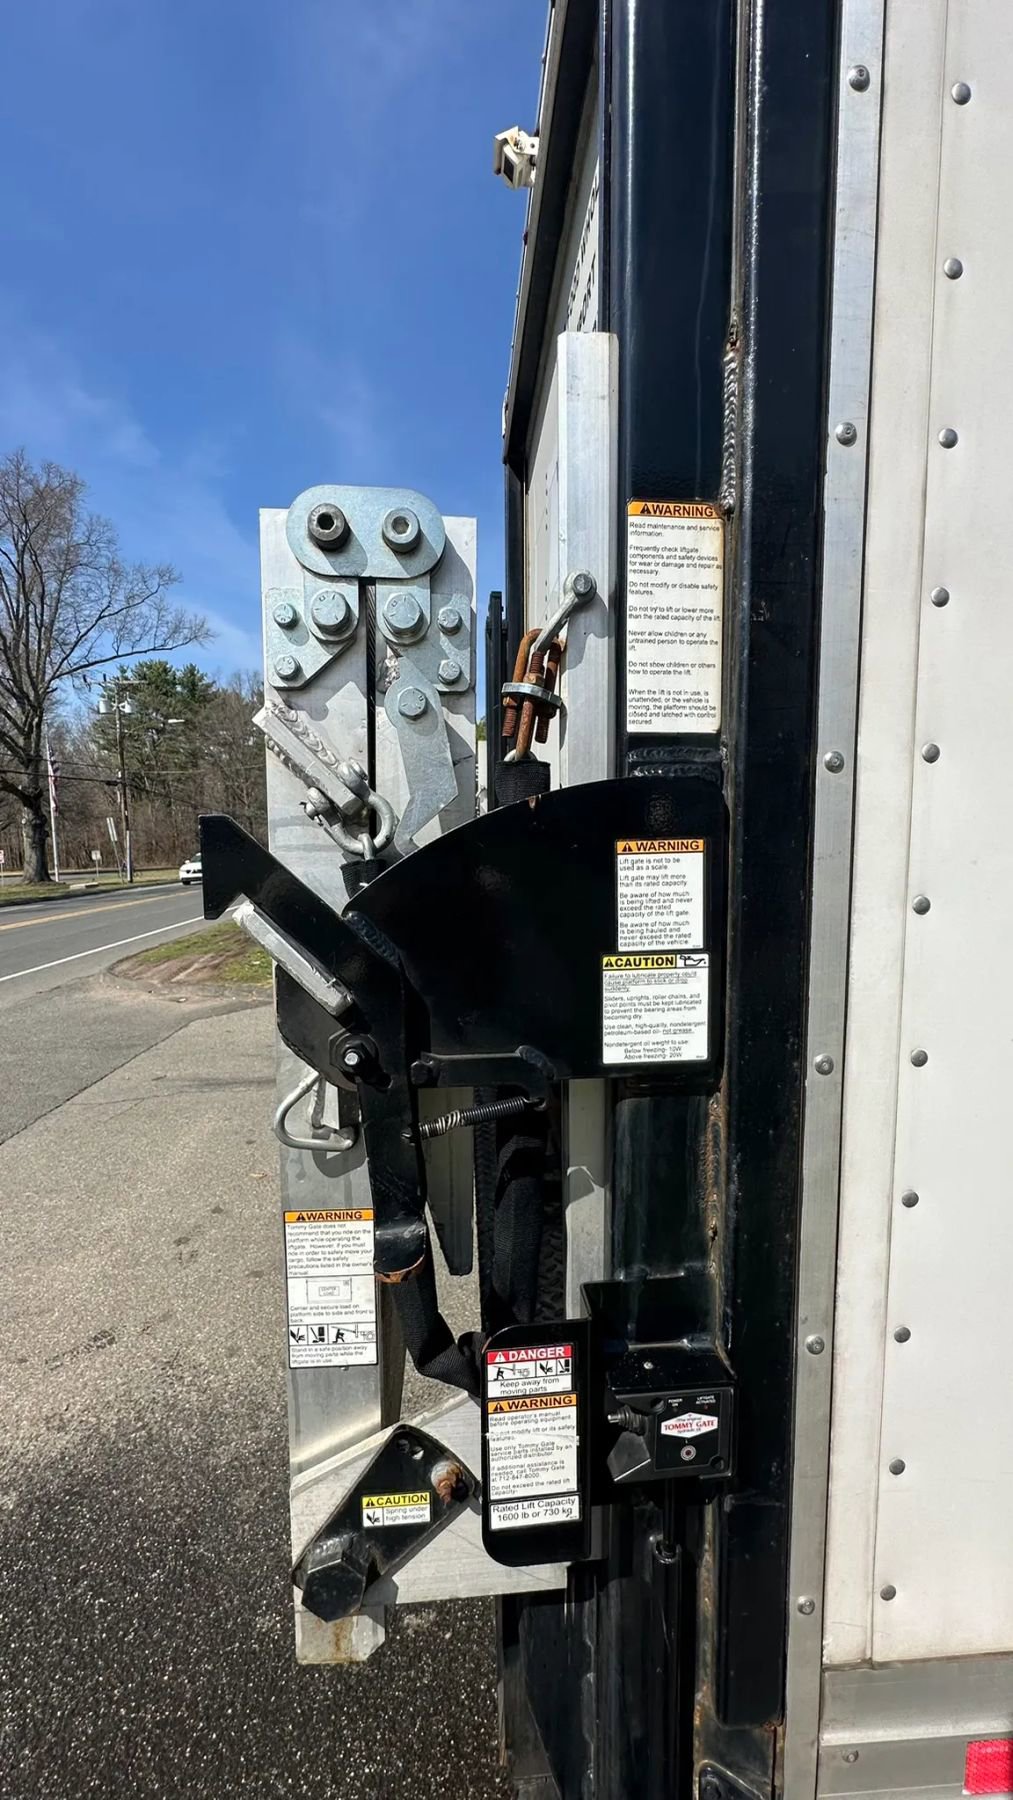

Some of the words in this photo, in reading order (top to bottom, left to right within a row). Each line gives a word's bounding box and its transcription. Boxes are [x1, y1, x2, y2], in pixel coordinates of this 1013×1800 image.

[651, 504, 714, 517] WARNING
[636, 840, 700, 852] WARNING
[614, 956, 674, 968] CAUTION
[305, 1211, 362, 1221] WARNING
[508, 1346, 565, 1361] DANGER
[507, 1395, 573, 1410] WARNING
[664, 1423, 693, 1431] TOMMY
[376, 1494, 428, 1506] CAUTION
[492, 1504, 519, 1513] Rated
[521, 1502, 535, 1510] Lift
[537, 1497, 576, 1508] Capacity
[497, 1512, 519, 1522] 1600
[521, 1511, 530, 1519] lb
[543, 1508, 560, 1516] 730
[561, 1507, 573, 1515] kg
